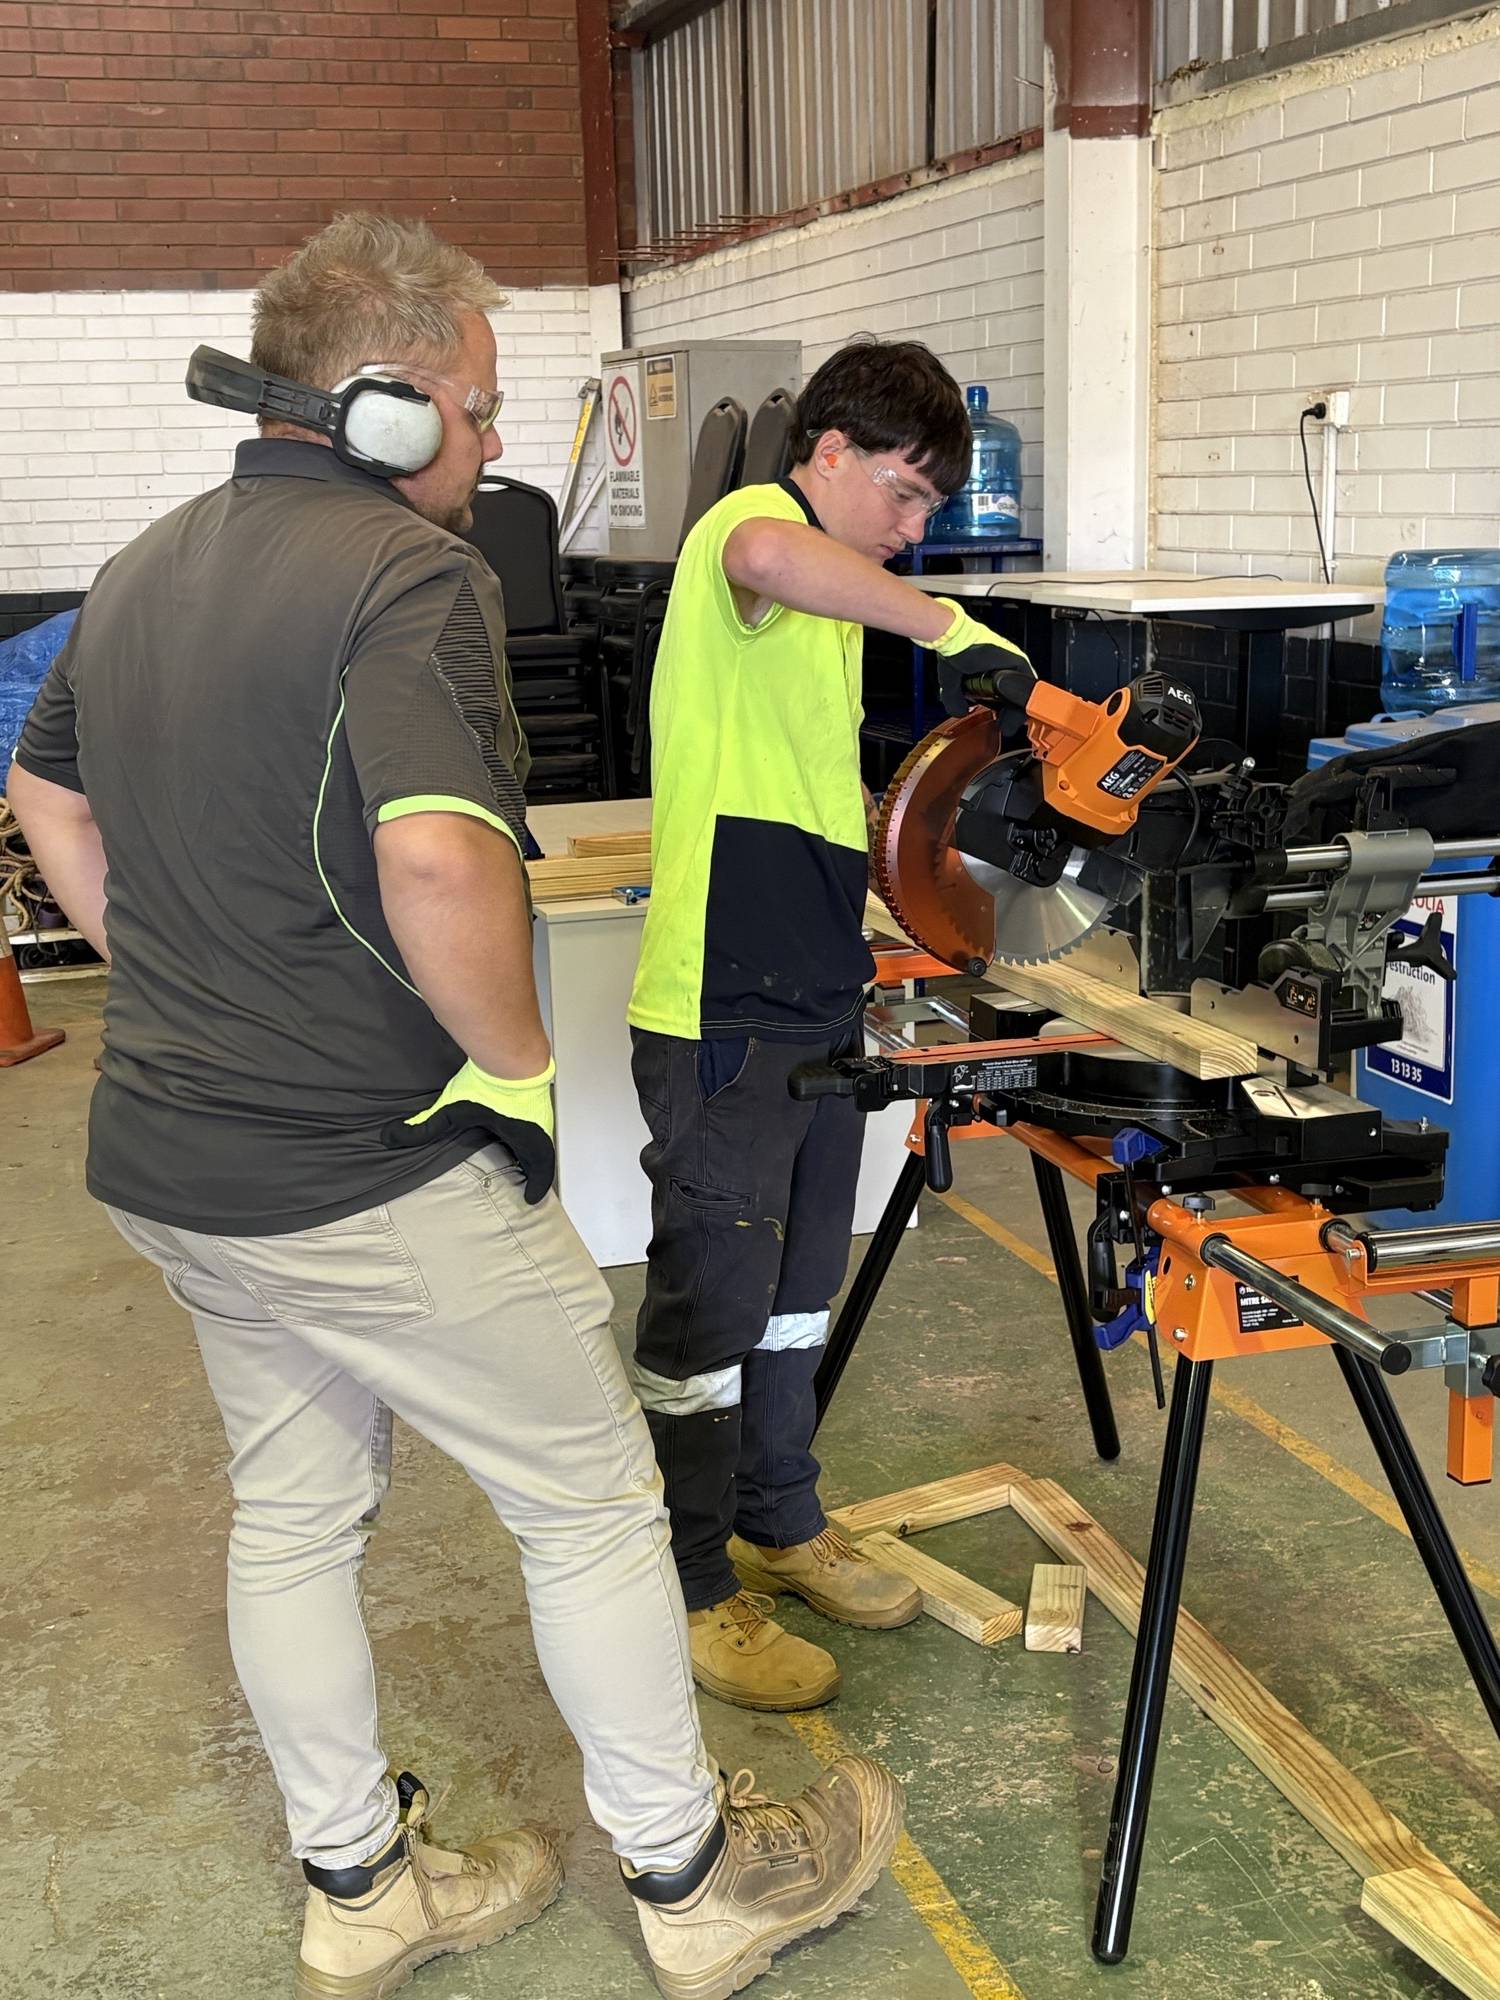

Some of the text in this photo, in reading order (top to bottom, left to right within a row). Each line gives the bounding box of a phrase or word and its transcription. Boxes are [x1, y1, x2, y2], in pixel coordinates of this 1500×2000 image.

[610, 470, 640, 482] FLAMMABLE
[611, 488, 639, 499] MATERIALS
[610, 505, 642, 516] NO SMOKING
[1167, 686, 1192, 705] AEG
[1101, 771, 1120, 790] AEG
[1410, 896, 1445, 915] OLIA
[1386, 961, 1436, 985] estruction
[1391, 1058, 1422, 1083] 13 13 35
